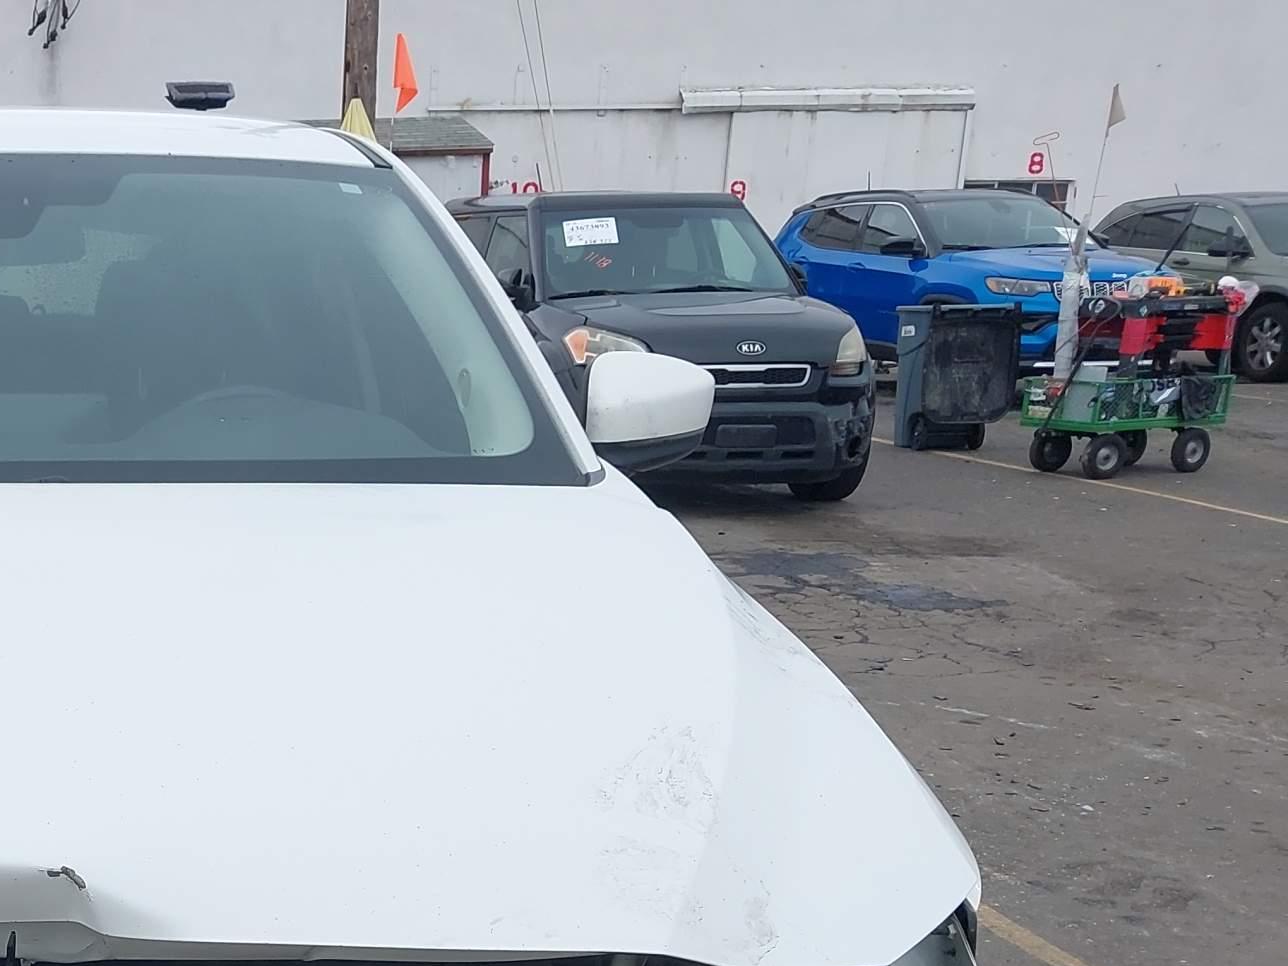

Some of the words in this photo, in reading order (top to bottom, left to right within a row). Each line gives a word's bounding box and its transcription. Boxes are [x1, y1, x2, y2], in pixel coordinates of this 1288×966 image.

[1028, 152, 1044, 174] 8
[730, 180, 746, 200] 9
[741, 343, 762, 353] KIA
